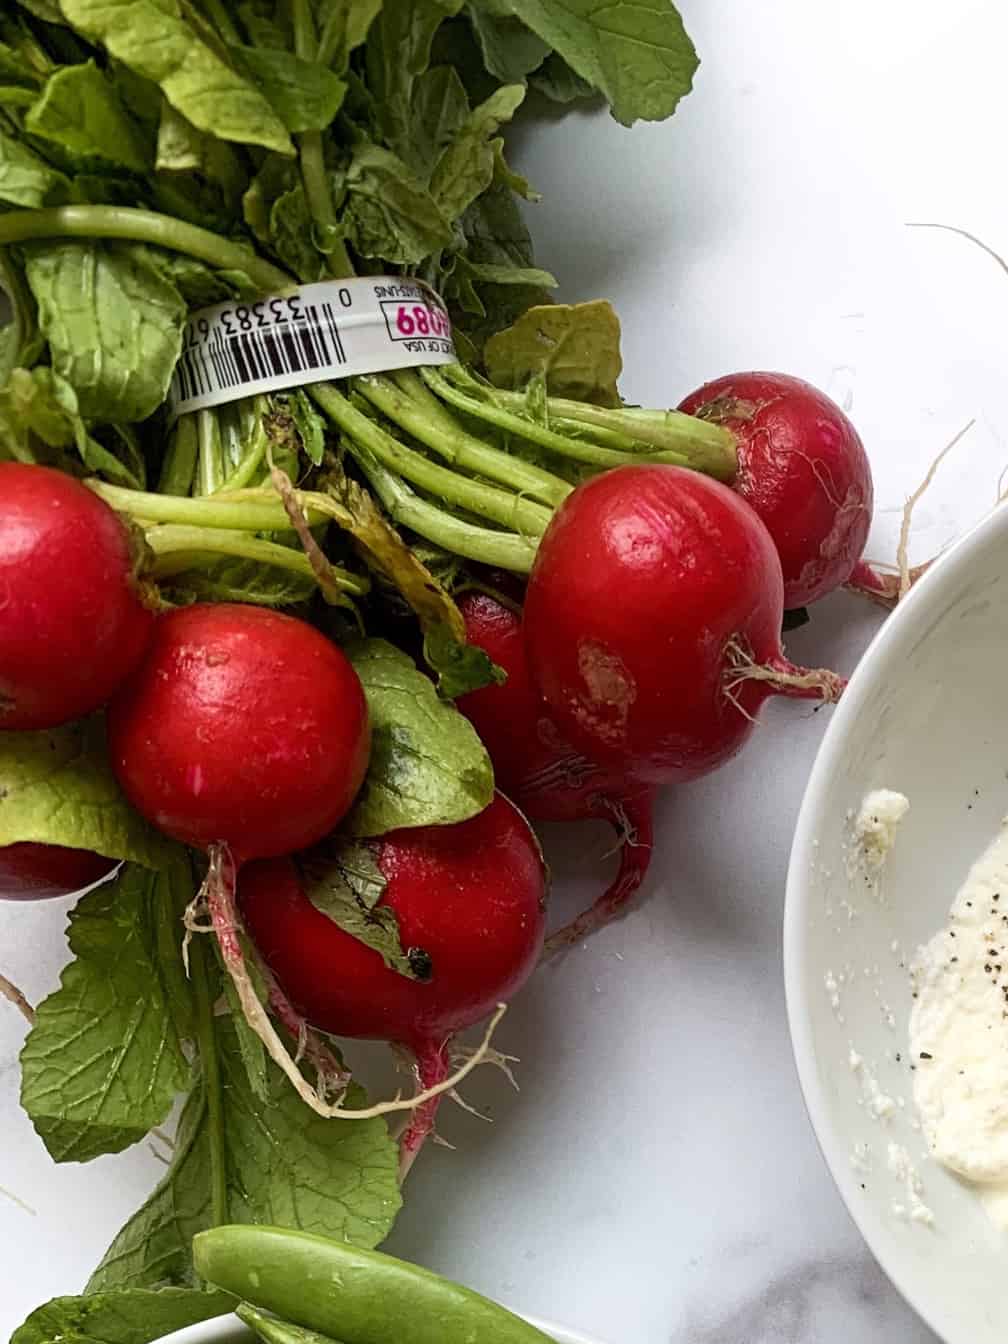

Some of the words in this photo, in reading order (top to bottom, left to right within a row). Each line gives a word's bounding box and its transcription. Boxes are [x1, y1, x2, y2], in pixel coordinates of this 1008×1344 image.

[338, 288, 353, 308] 0
[220, 295, 305, 335] 33383
[402, 340, 426, 353] USA
